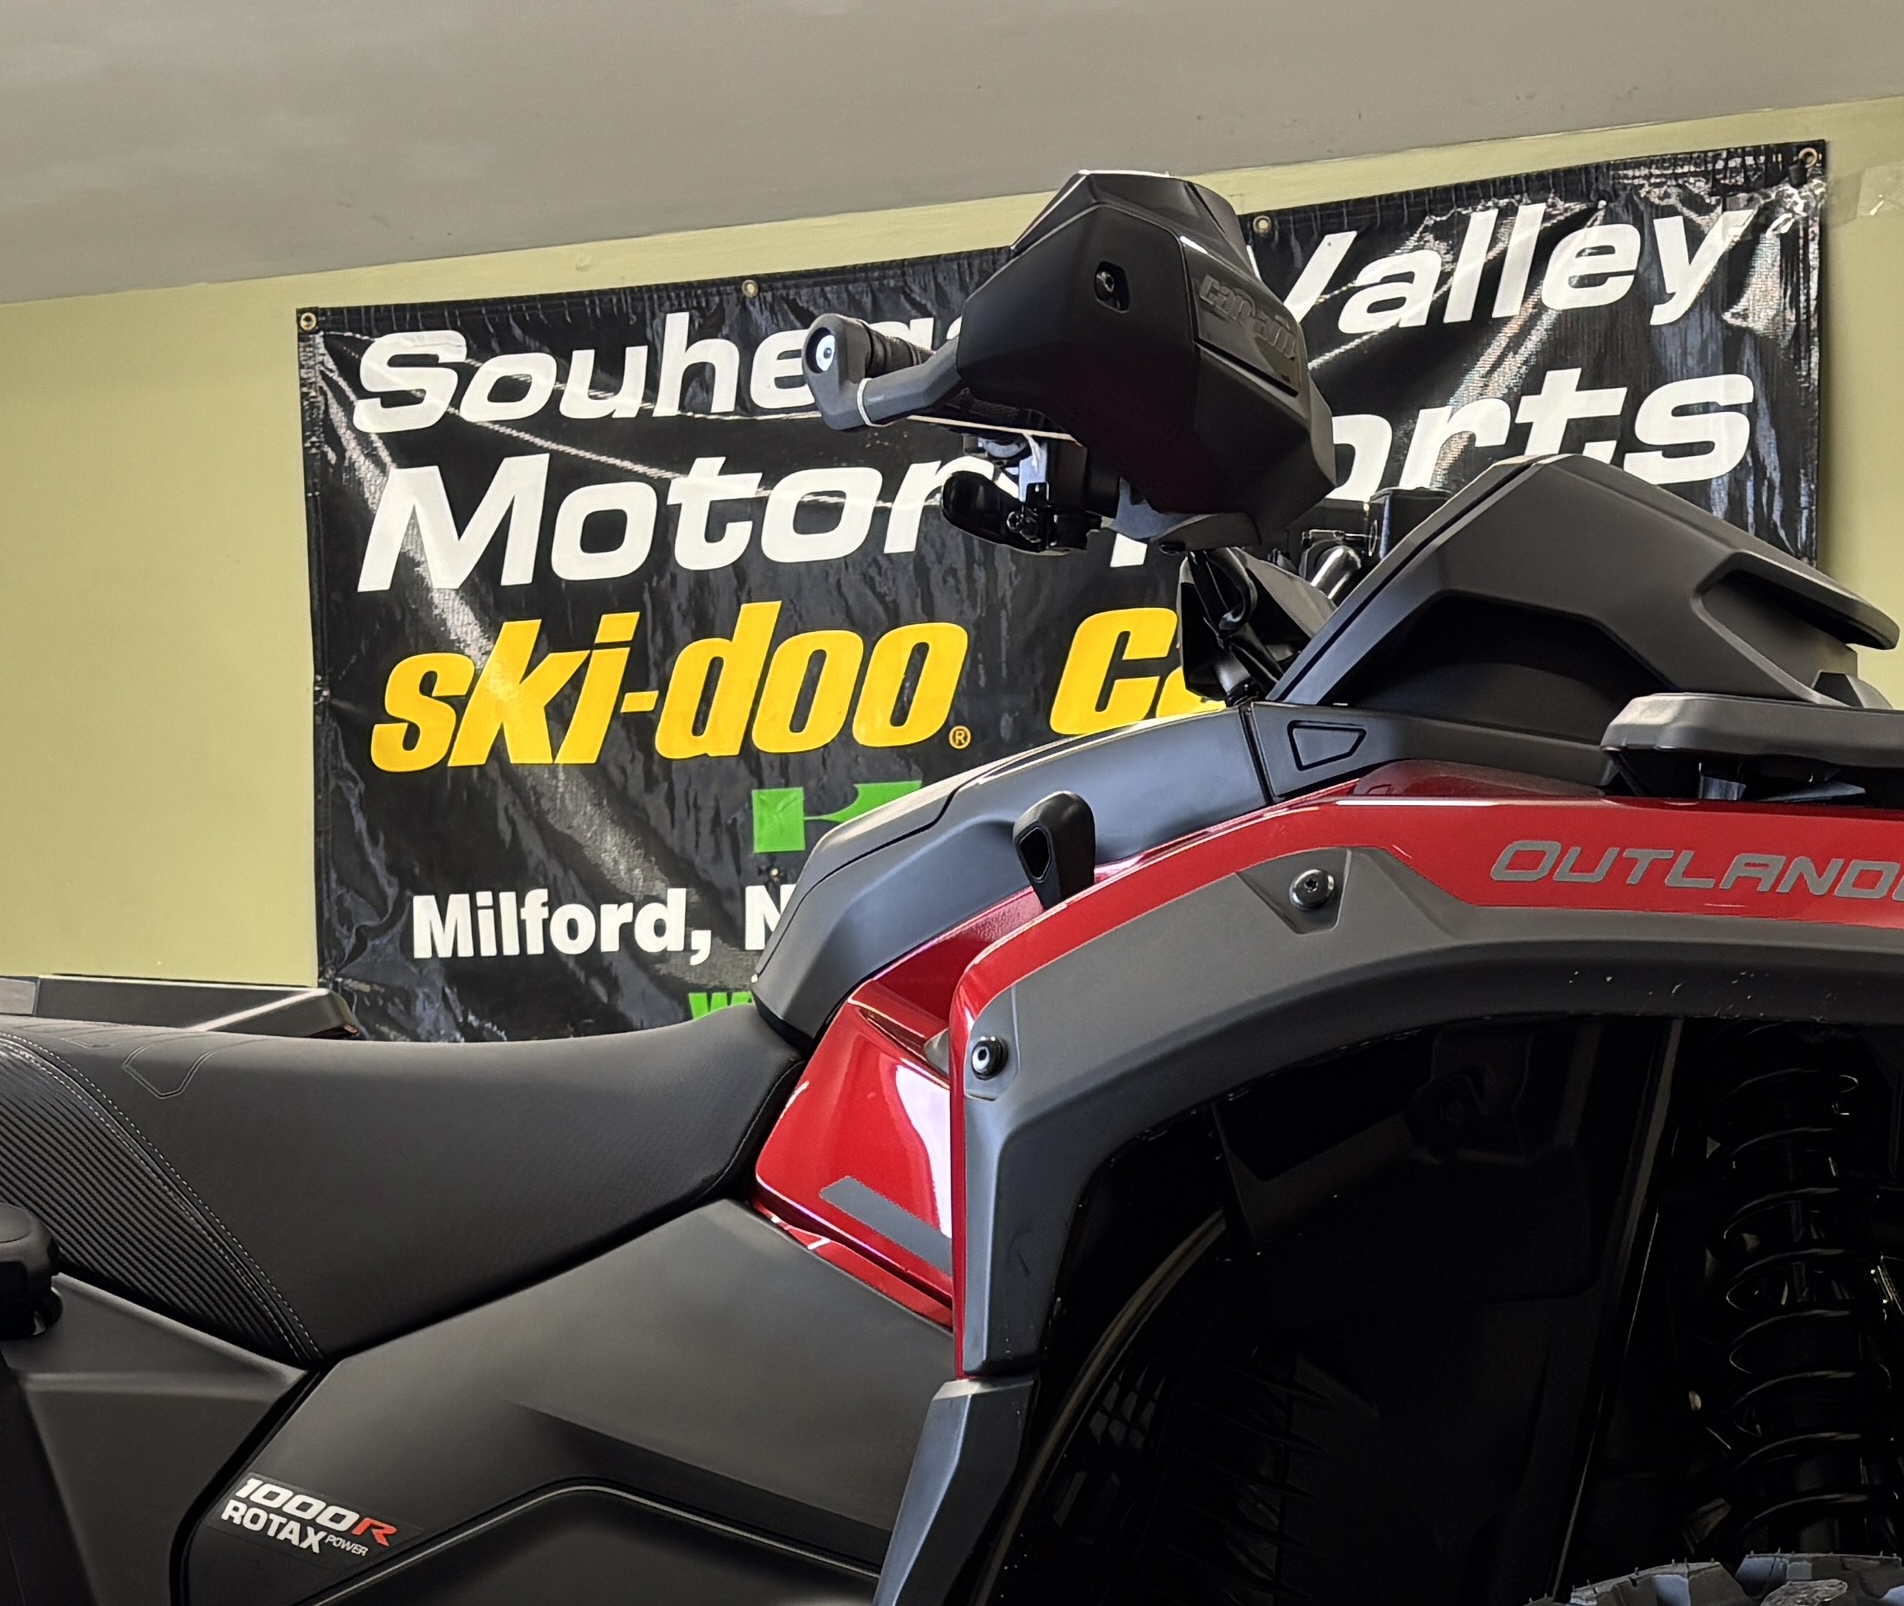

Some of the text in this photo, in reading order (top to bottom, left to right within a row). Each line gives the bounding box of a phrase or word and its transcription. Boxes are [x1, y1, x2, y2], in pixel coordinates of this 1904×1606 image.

[412, 883, 798, 967] Milford, N
[221, 1499, 369, 1557] ROTAX POWER
[235, 1477, 398, 1547] 1000R
